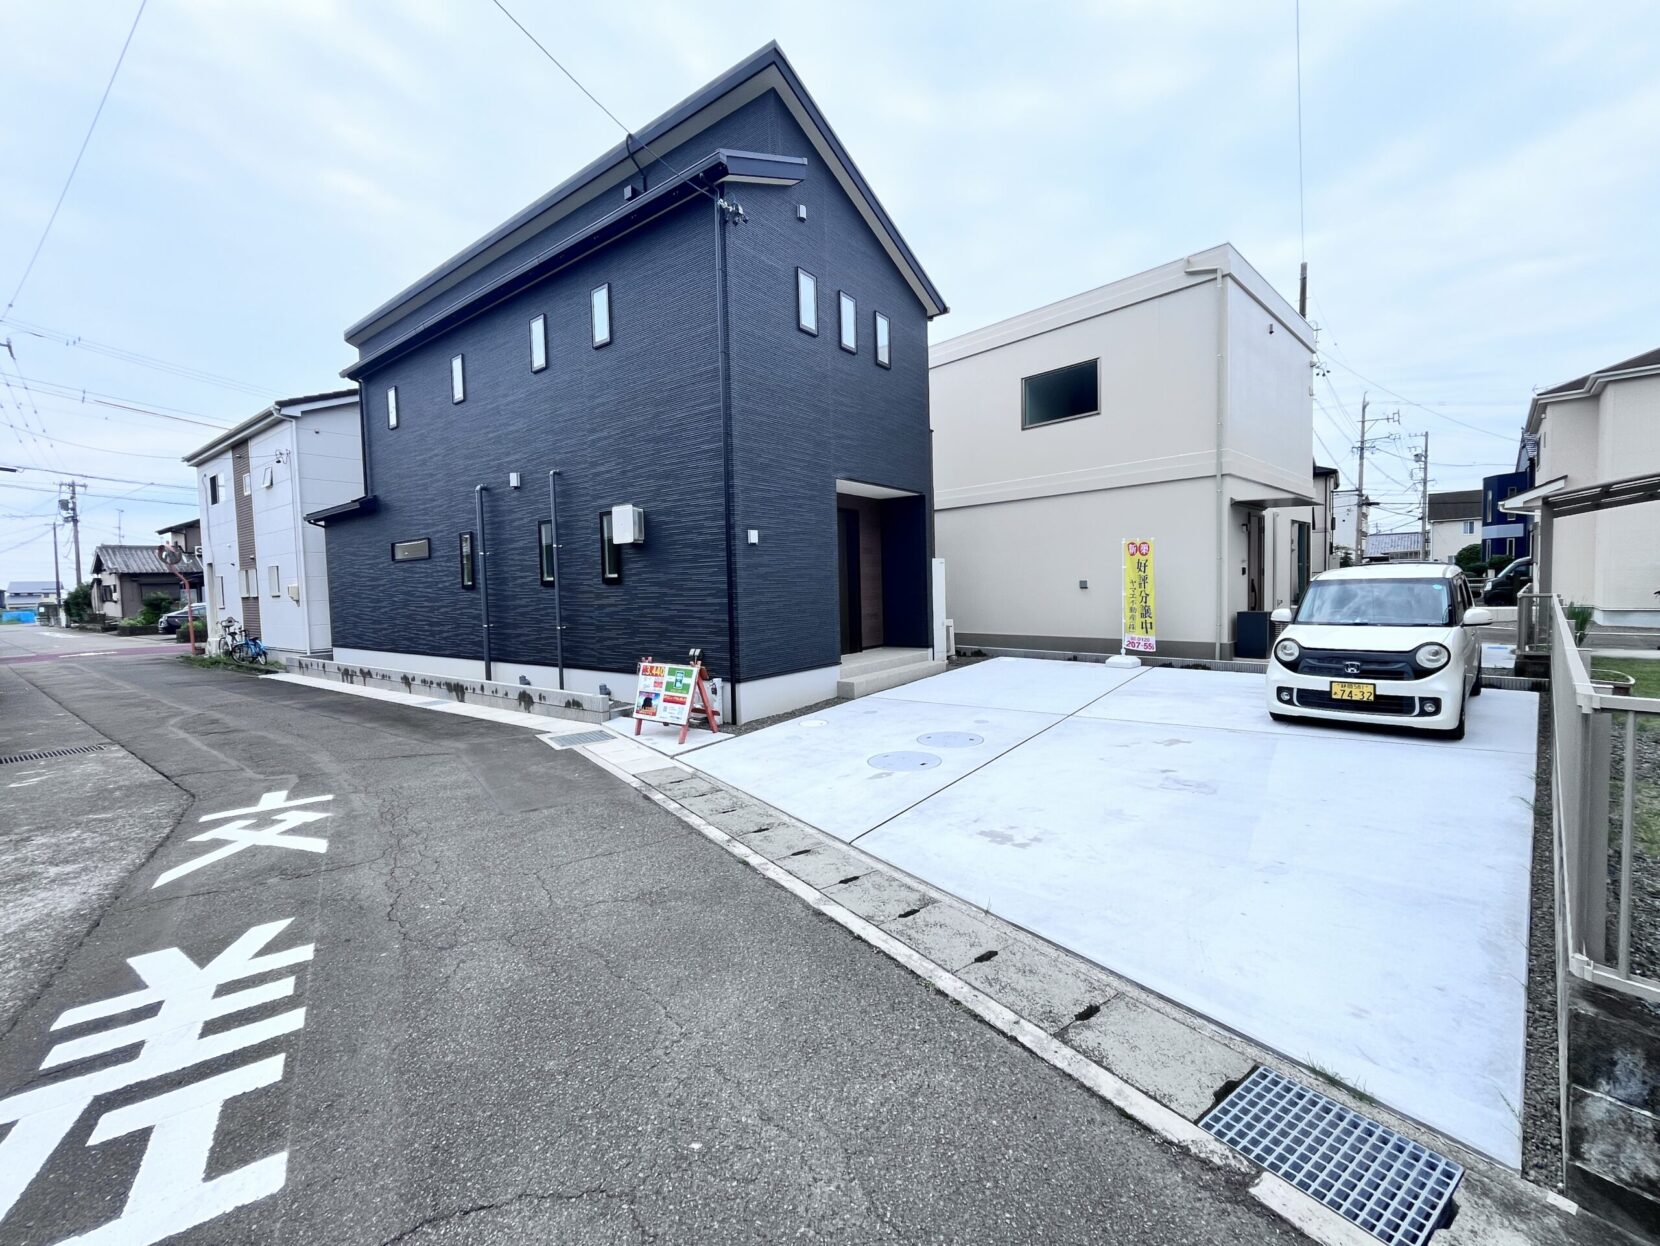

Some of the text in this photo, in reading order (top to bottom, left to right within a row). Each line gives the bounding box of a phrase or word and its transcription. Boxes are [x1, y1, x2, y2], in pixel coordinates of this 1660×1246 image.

[1137, 559, 1152, 634] 好評分譲中
[1340, 689, 1372, 700] 74-32
